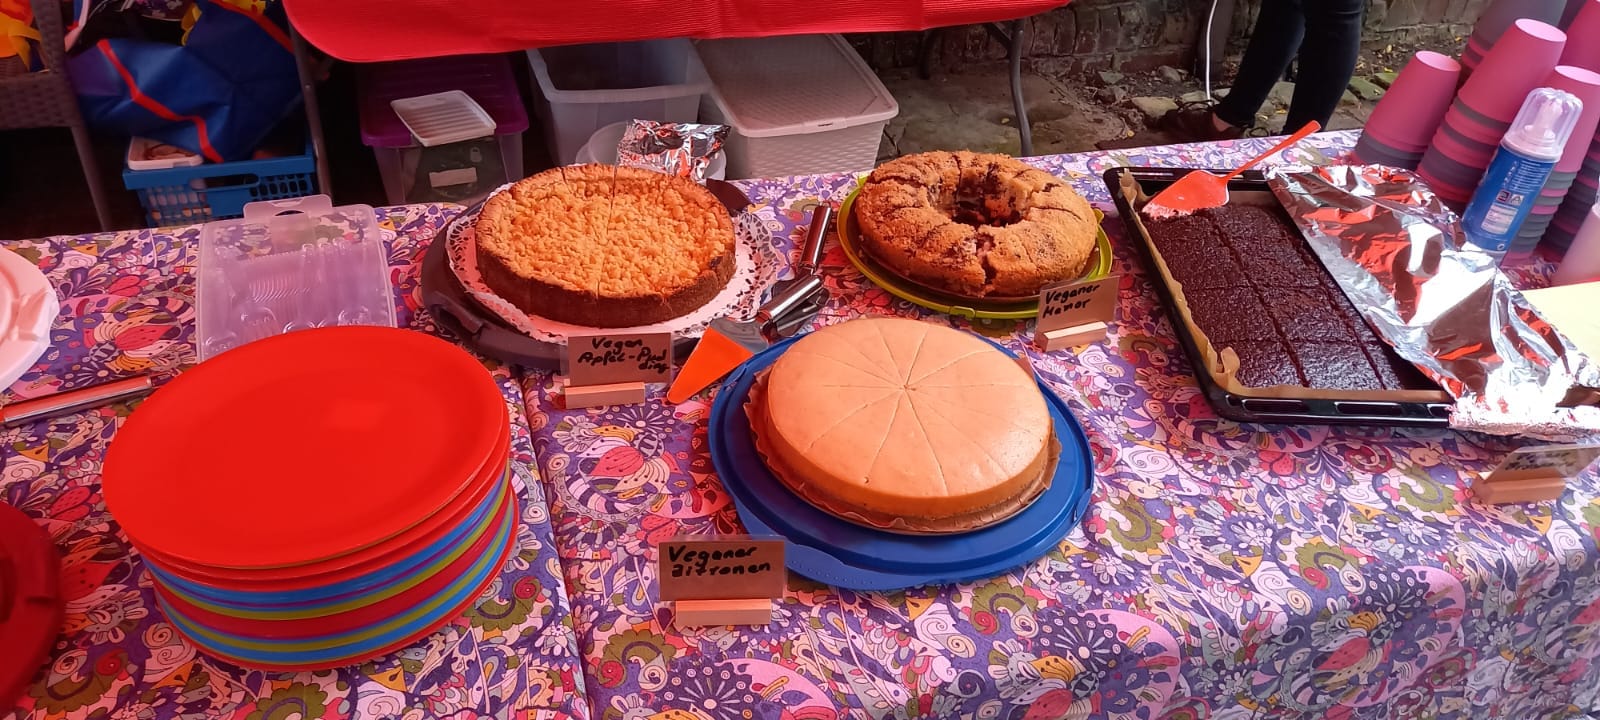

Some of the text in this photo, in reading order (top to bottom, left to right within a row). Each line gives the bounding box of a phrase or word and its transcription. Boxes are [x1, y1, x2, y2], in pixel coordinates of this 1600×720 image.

[1046, 285, 1100, 304] Veganer
[592, 338, 642, 355] Vegan
[669, 546, 757, 566] Veganer
